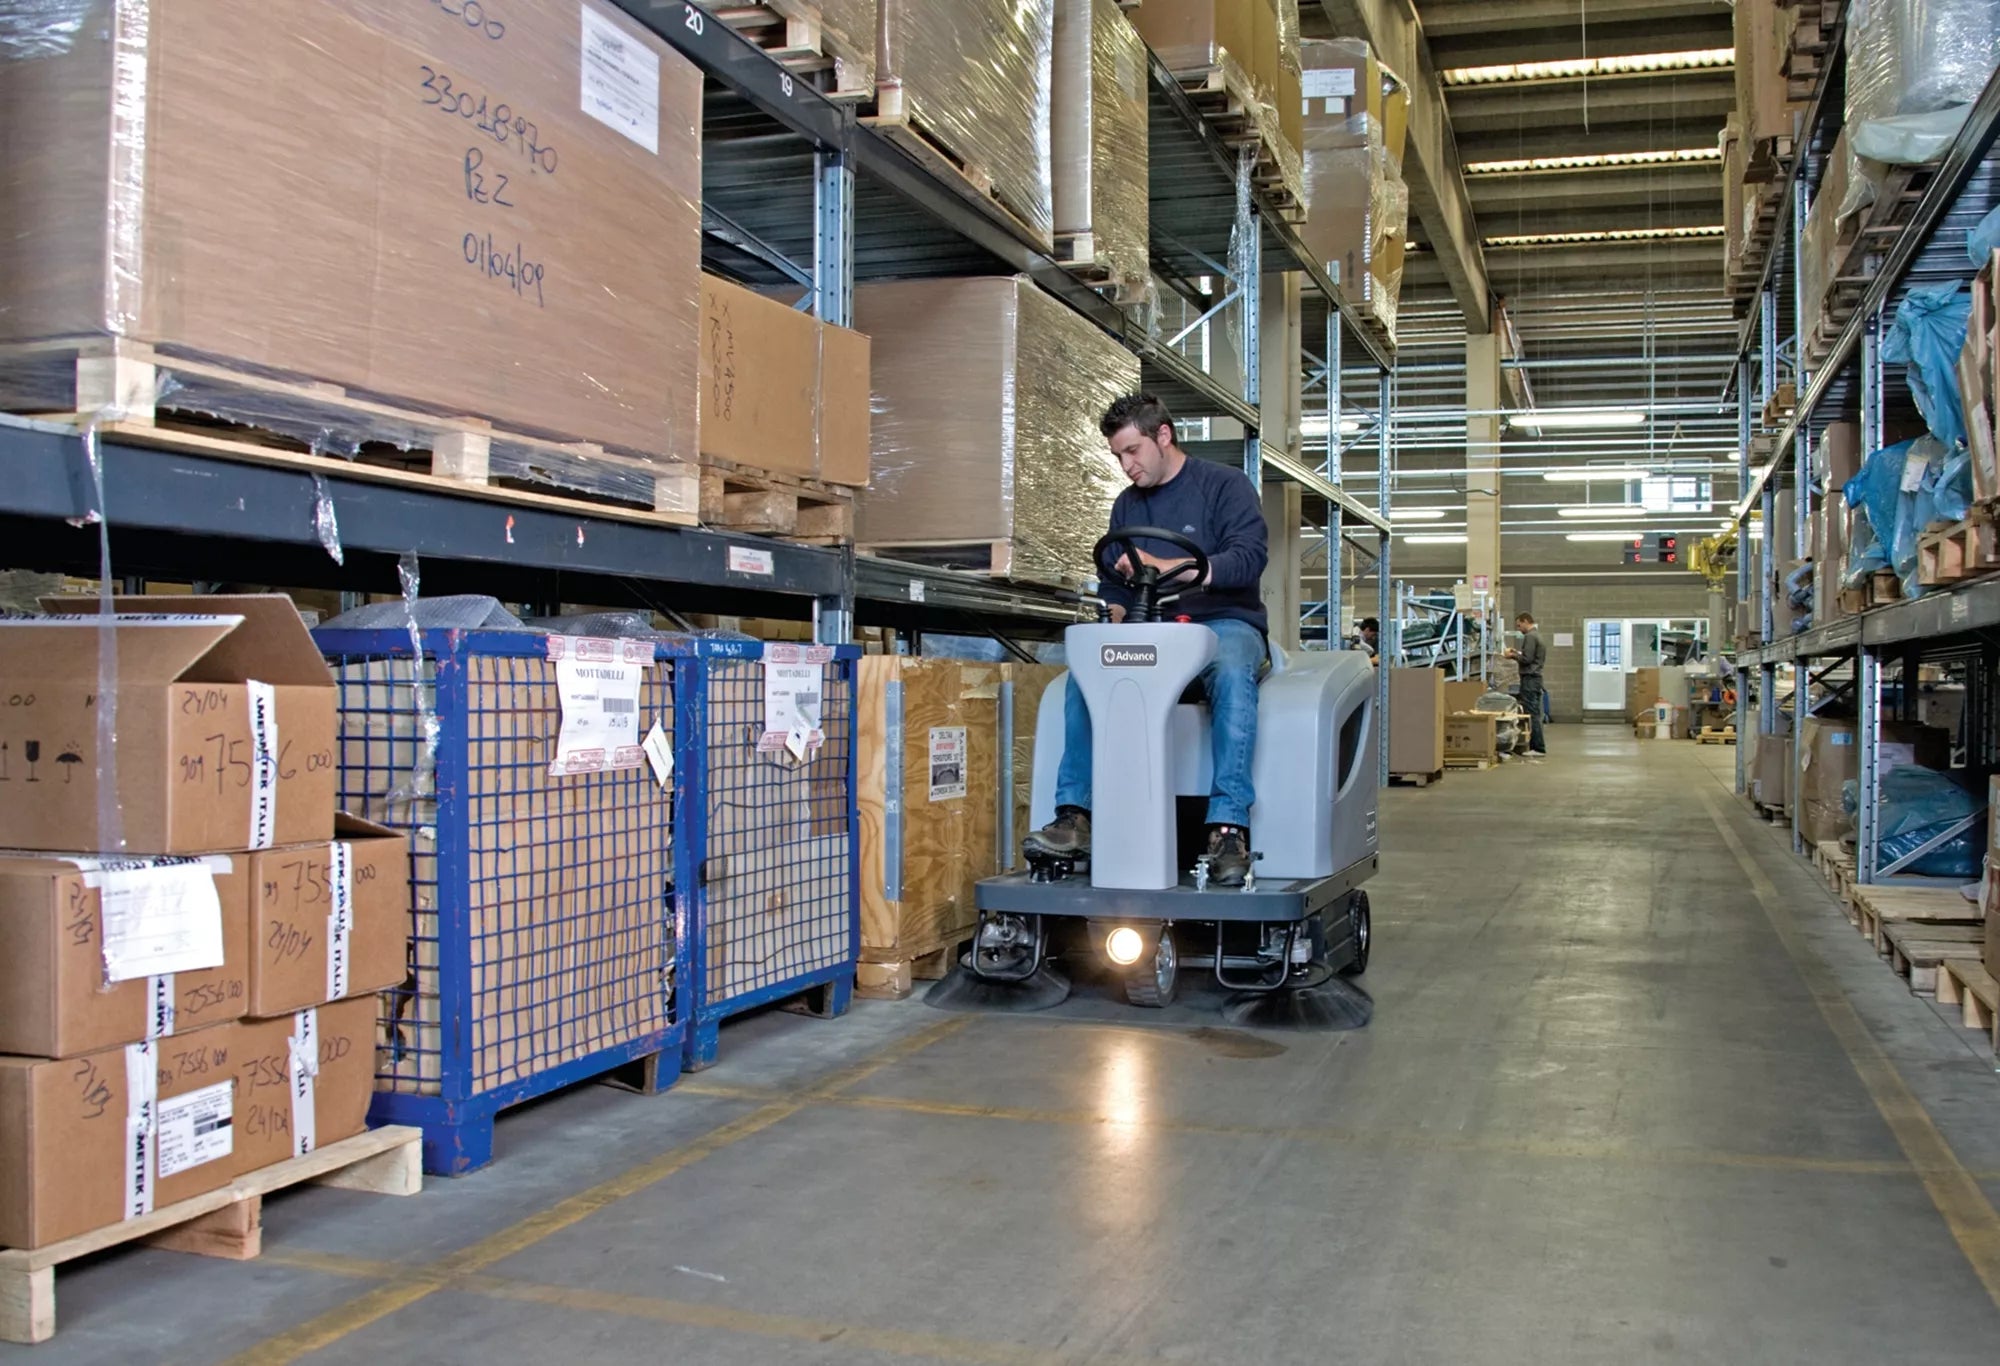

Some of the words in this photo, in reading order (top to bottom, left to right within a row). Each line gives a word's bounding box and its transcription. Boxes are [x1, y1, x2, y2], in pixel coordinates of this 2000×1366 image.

[684, 4, 704, 36] 20
[779, 71, 793, 97] 19
[1116, 651, 1155, 661] Advance
[256, 796, 267, 848] ITALIA
[281, 860, 334, 913] 755
[134, 1132, 145, 1196] METEK
